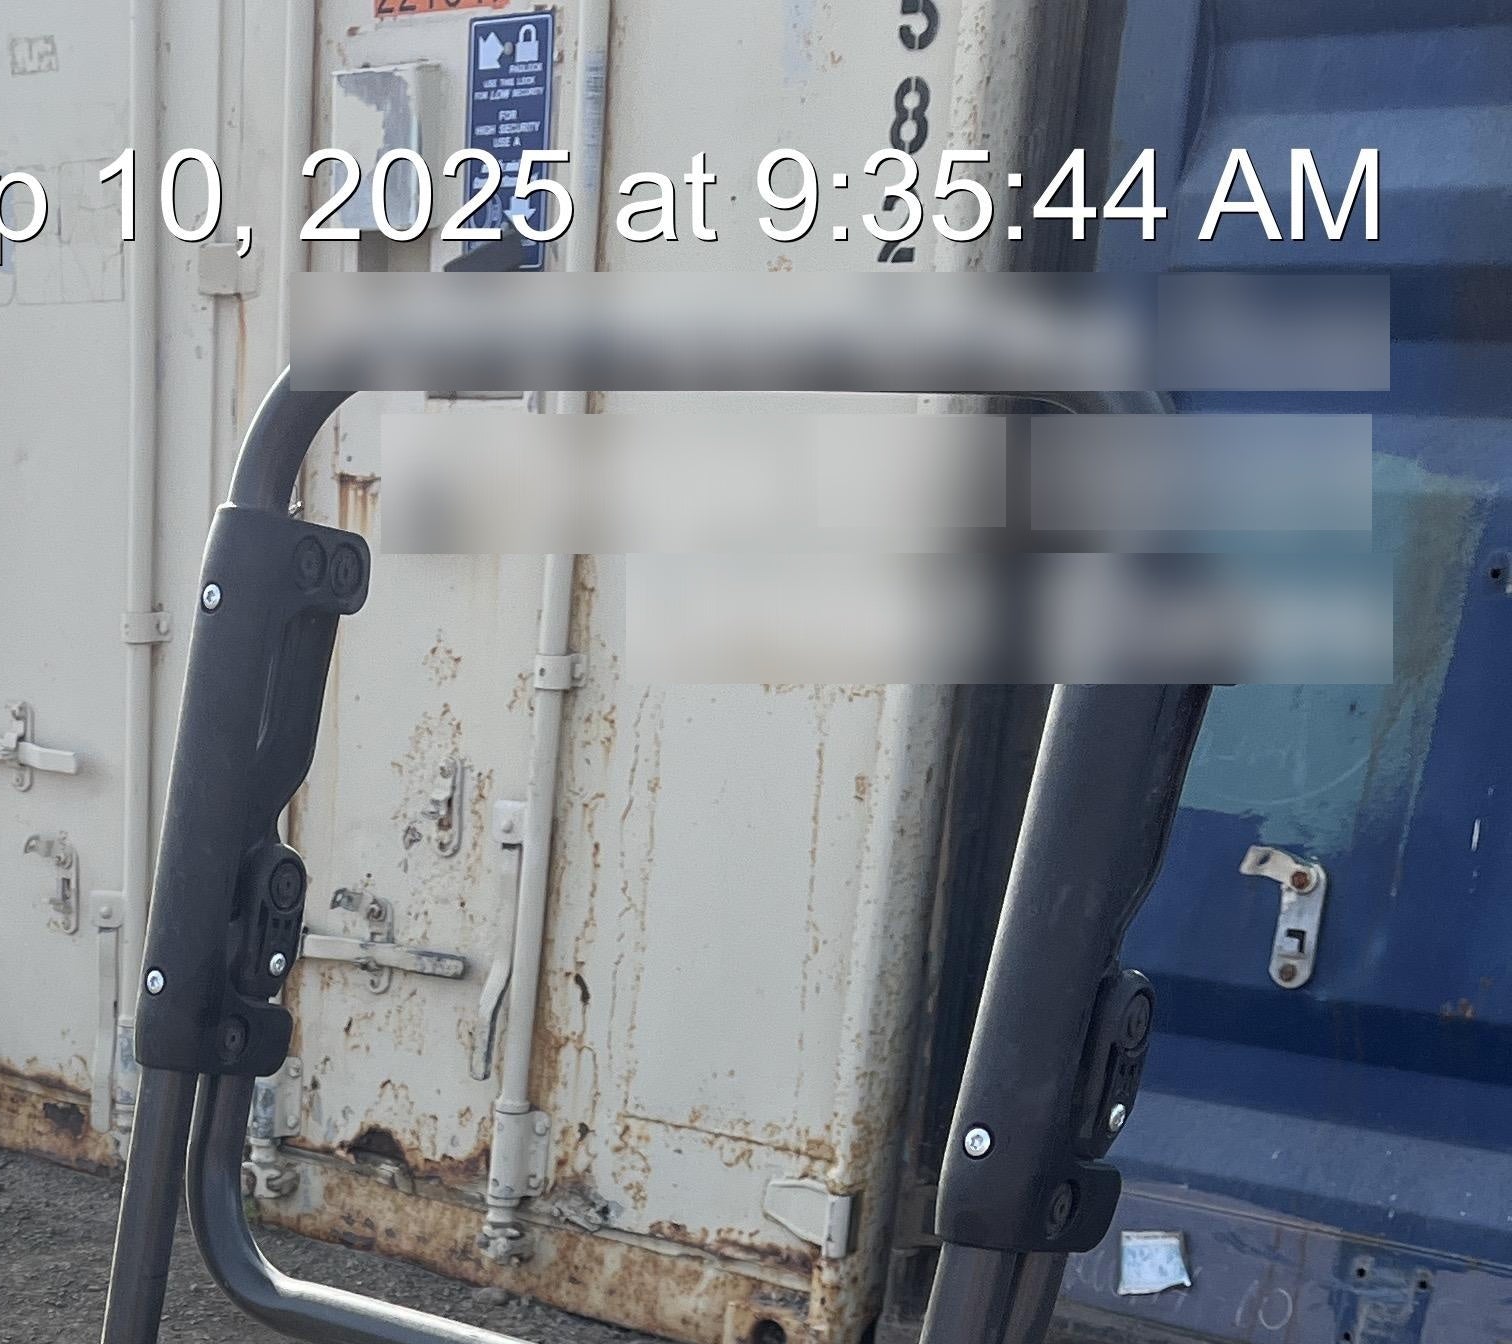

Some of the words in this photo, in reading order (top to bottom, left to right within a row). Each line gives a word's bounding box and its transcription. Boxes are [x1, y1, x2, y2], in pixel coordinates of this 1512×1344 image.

[489, 88, 511, 101] LOW
[498, 109, 518, 121] FOR
[474, 124, 497, 136] HIGH
[498, 121, 541, 134] SECURITY
[492, 136, 511, 148] USE
[512, 135, 522, 147] A
